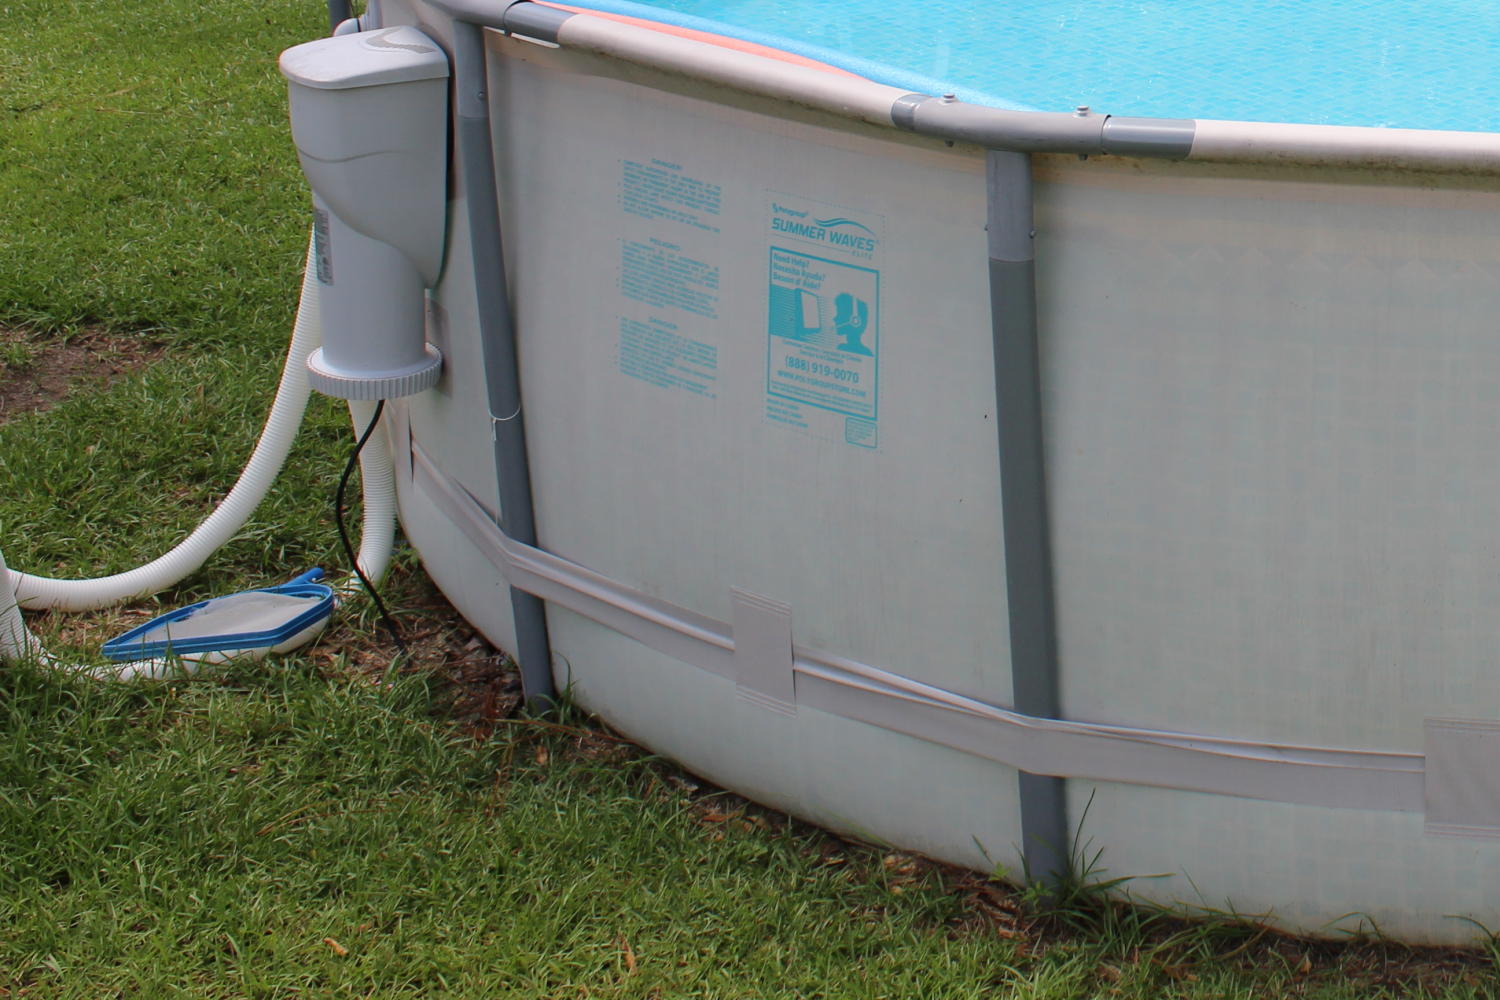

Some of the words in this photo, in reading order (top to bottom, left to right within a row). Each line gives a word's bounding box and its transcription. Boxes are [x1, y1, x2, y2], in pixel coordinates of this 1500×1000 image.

[772, 217, 826, 240] SUMMER
[830, 230, 874, 251] WAVES
[785, 355, 810, 371] (888)
[811, 362, 860, 383] 919-0070
